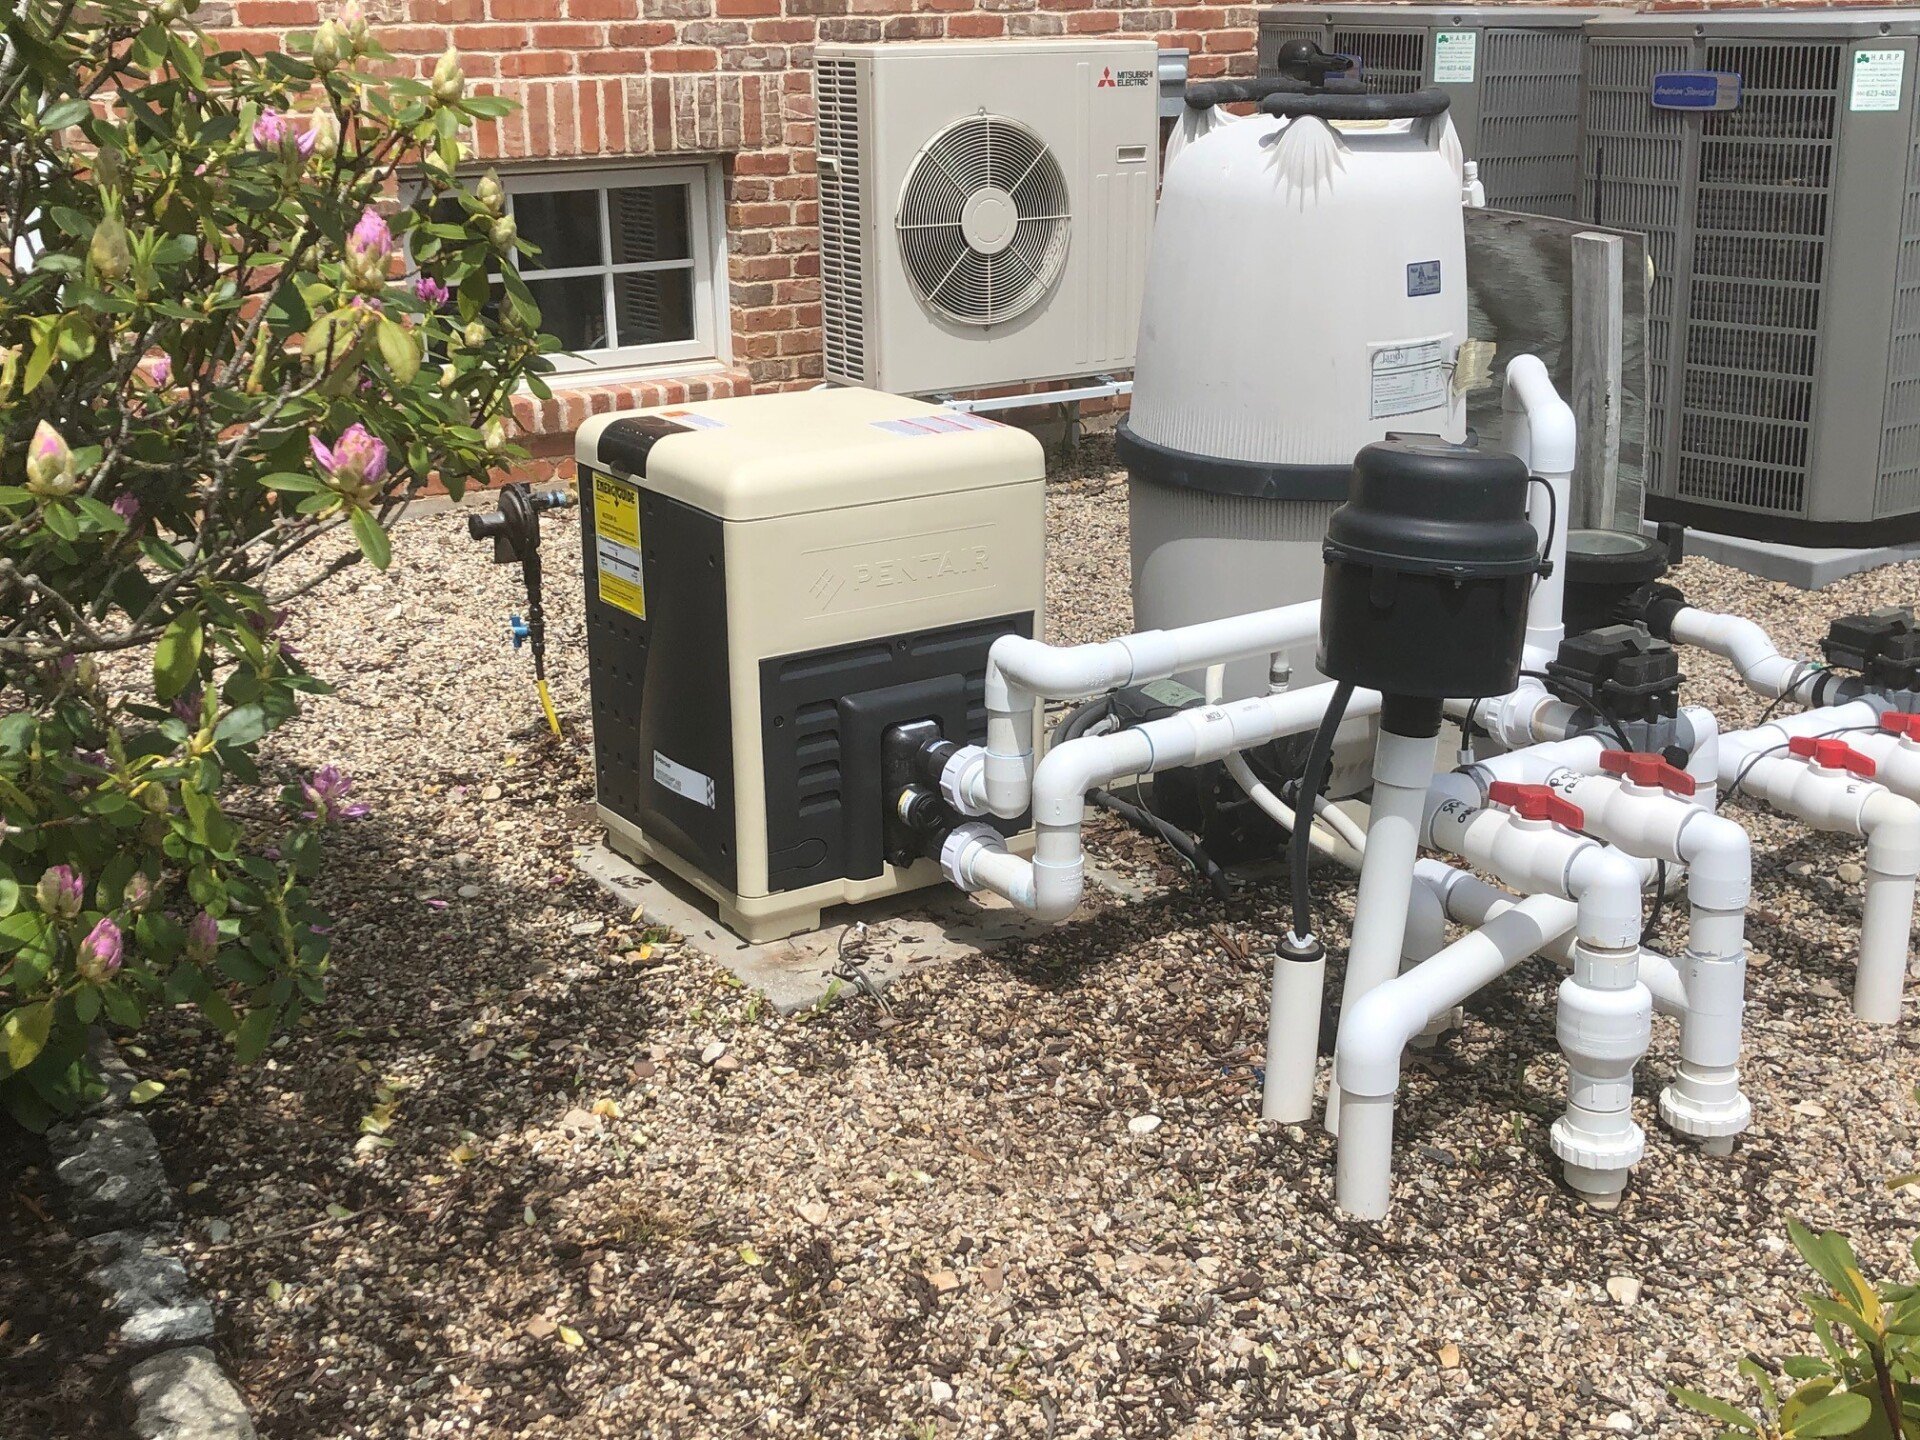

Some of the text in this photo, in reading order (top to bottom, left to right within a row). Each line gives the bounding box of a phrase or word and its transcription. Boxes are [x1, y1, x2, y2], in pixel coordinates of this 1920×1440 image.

[1117, 70, 1153, 79] MITSUBISHI
[1117, 78, 1148, 87] ELECTRIC
[852, 545, 990, 592] PENTAIR
